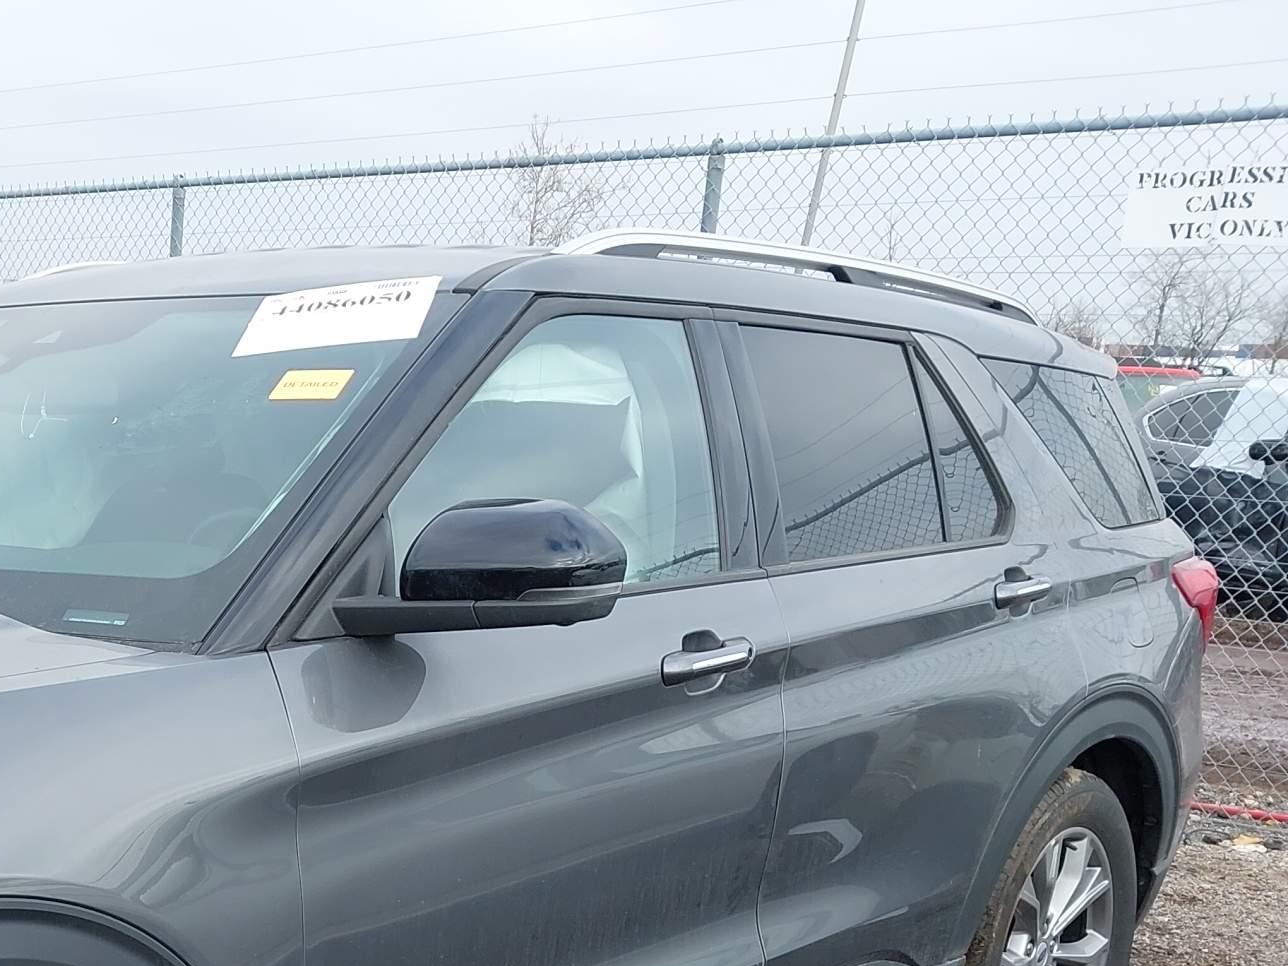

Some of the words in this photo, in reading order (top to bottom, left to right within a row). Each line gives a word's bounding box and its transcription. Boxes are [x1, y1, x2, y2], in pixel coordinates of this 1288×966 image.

[1185, 191, 1255, 213] CARS
[1168, 222, 1213, 240] VIC
[1220, 218, 1288, 238] ONLY
